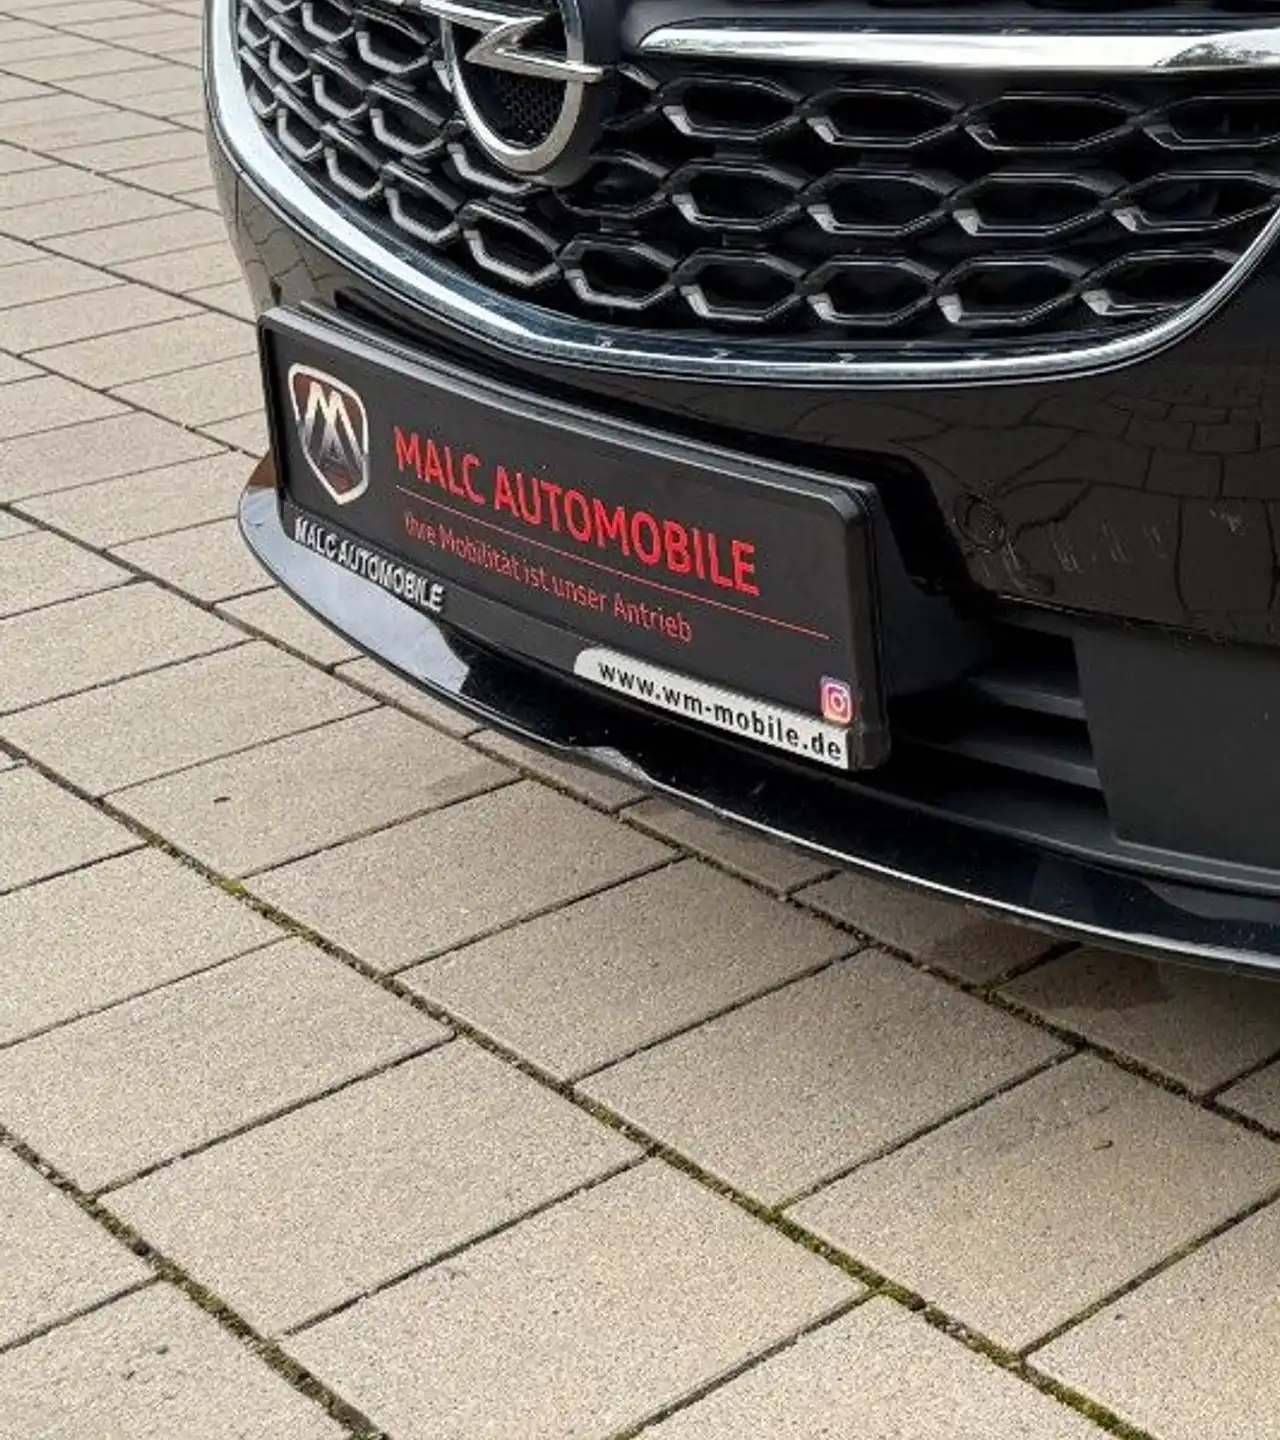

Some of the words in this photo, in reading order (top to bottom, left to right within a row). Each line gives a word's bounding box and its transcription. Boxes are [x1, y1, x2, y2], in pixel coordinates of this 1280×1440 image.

[294, 515, 339, 558] MALC
[338, 539, 445, 613] AUTOMOBILE
[394, 425, 485, 505] MALC
[494, 465, 760, 597] AUTOMOBILE
[438, 523, 521, 581] Mobilität
[522, 558, 549, 592] ist
[551, 575, 606, 611] unser
[613, 592, 693, 644] Antrieb
[598, 661, 842, 760] www.wm-mobile.de
